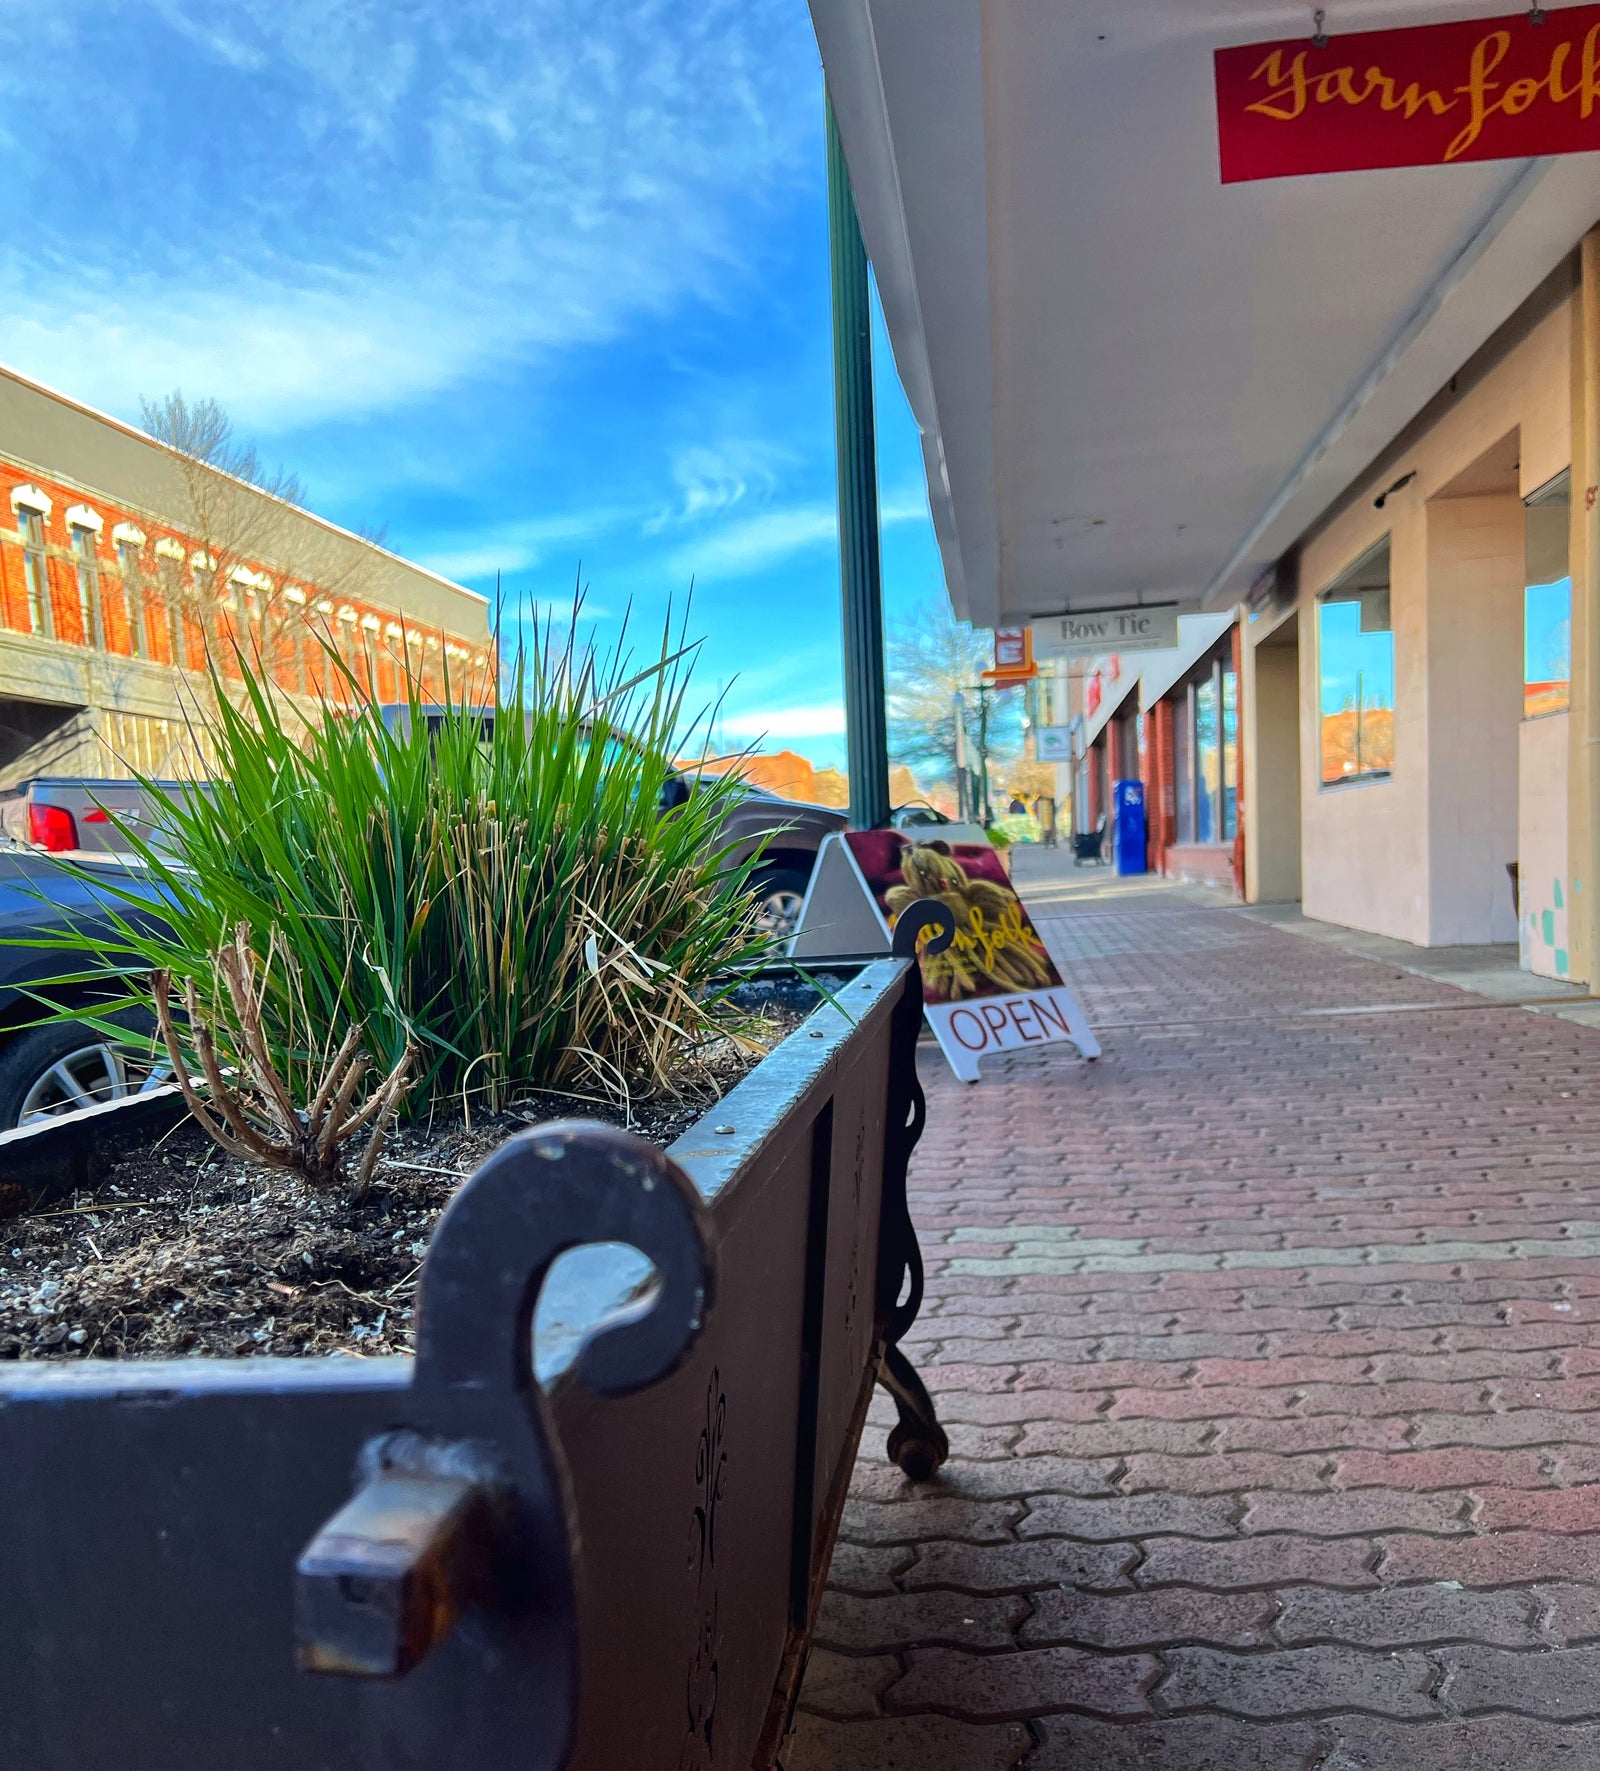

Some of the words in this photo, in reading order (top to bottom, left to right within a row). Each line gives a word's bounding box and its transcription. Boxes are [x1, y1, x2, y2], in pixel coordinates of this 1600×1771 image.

[1060, 617, 1108, 640] Bow
[1116, 613, 1151, 635] Tie
[949, 996, 1072, 1052] OPEN
